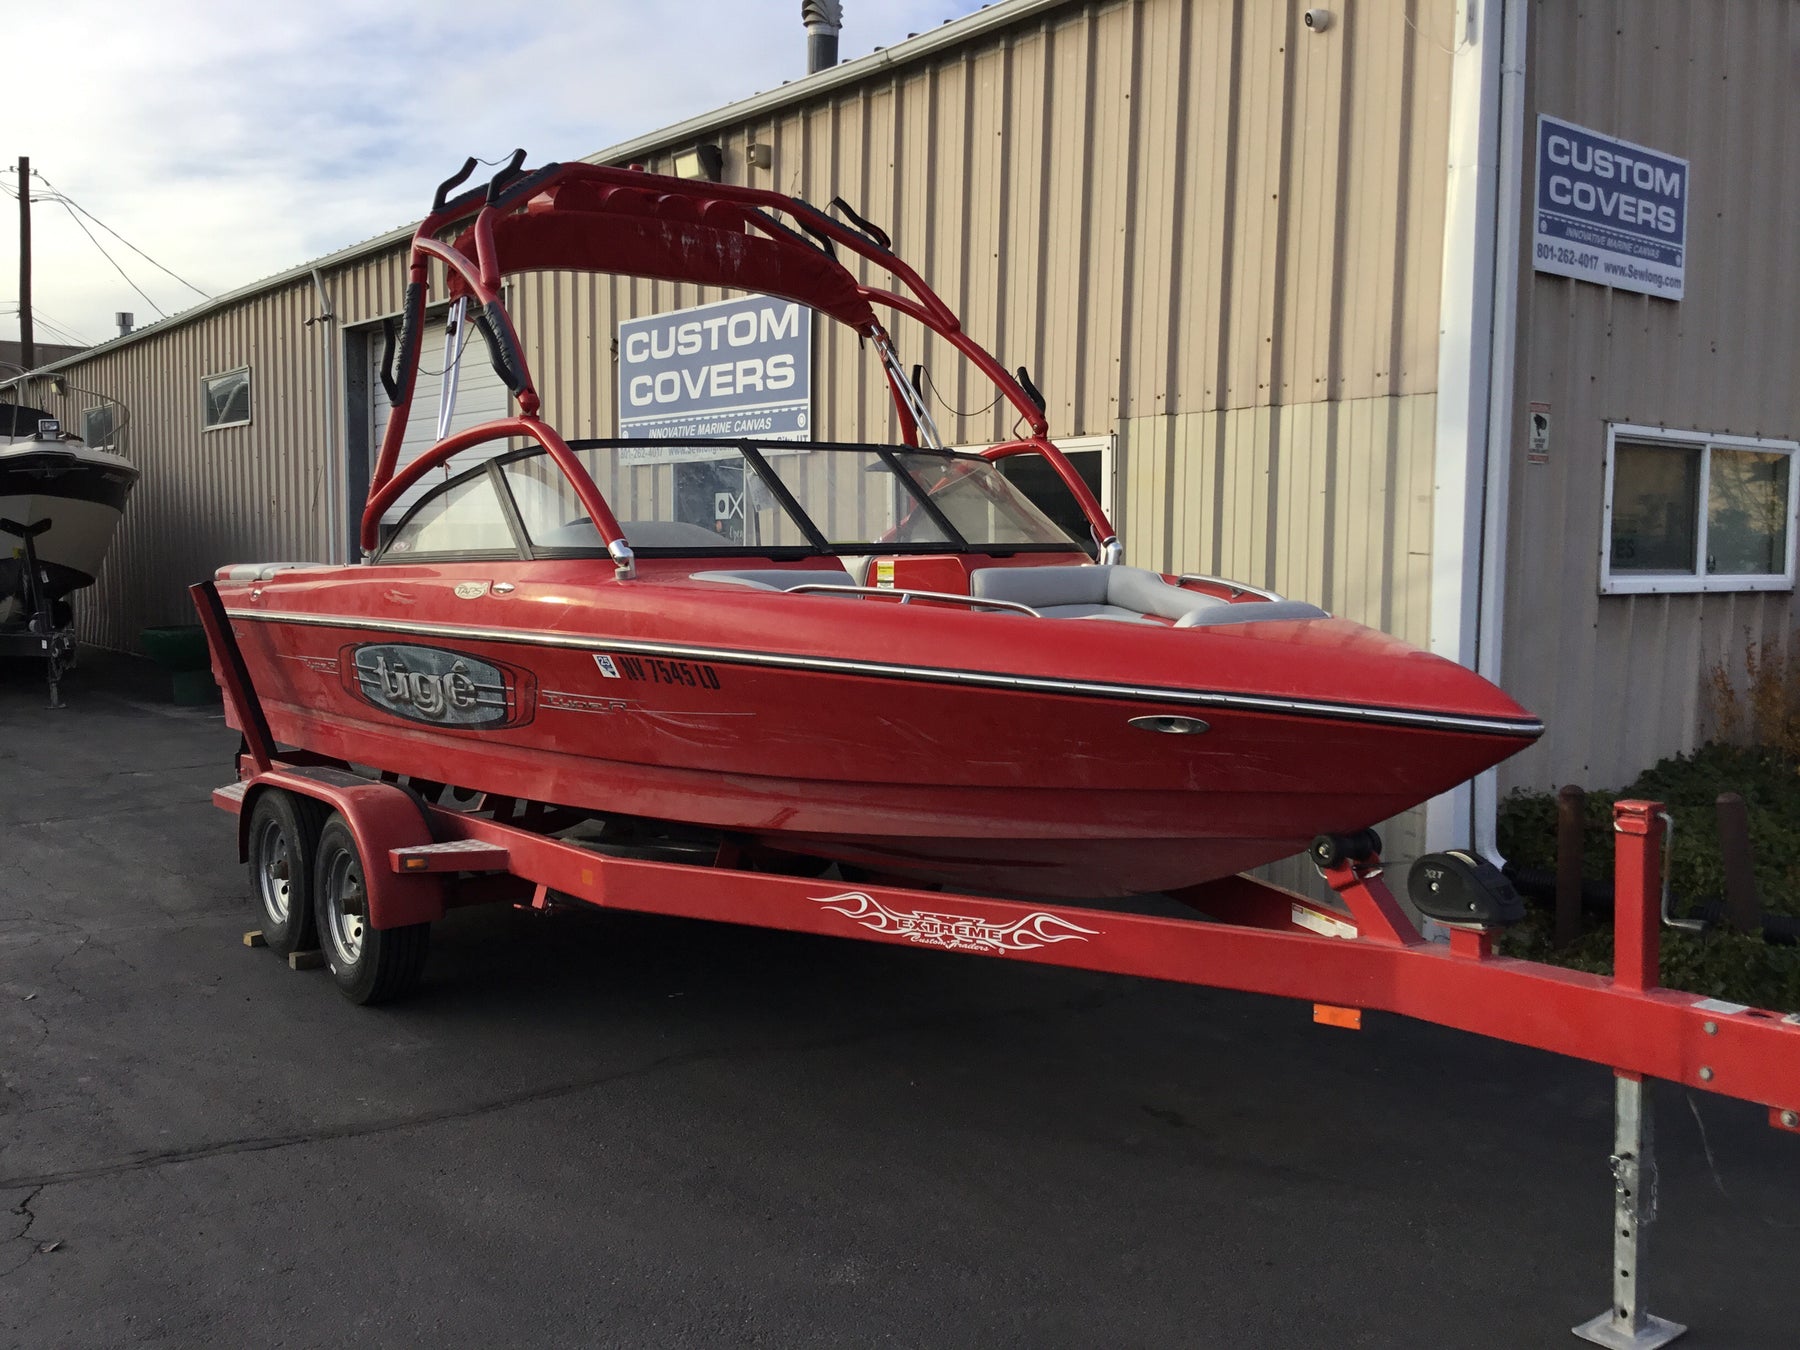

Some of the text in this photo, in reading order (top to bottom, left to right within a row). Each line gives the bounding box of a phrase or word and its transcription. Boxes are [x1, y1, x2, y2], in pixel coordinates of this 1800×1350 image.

[1547, 135, 1680, 199] CUSTOM
[1549, 175, 1676, 233] COVERS
[1566, 226, 1660, 259] INNOVATIVE MARINE CANVAS
[1537, 243, 1682, 289] 801-262-4017 www.Sewlong.com
[626, 303, 799, 363] CUSTOM
[630, 353, 796, 406] COVERS
[649, 417, 772, 439] INNOVATIVE MARINE CANVAS
[619, 656, 721, 690] NV 7545 LD
[897, 918, 1002, 941] EXTREME
[911, 934, 990, 952] Custom Trailers
